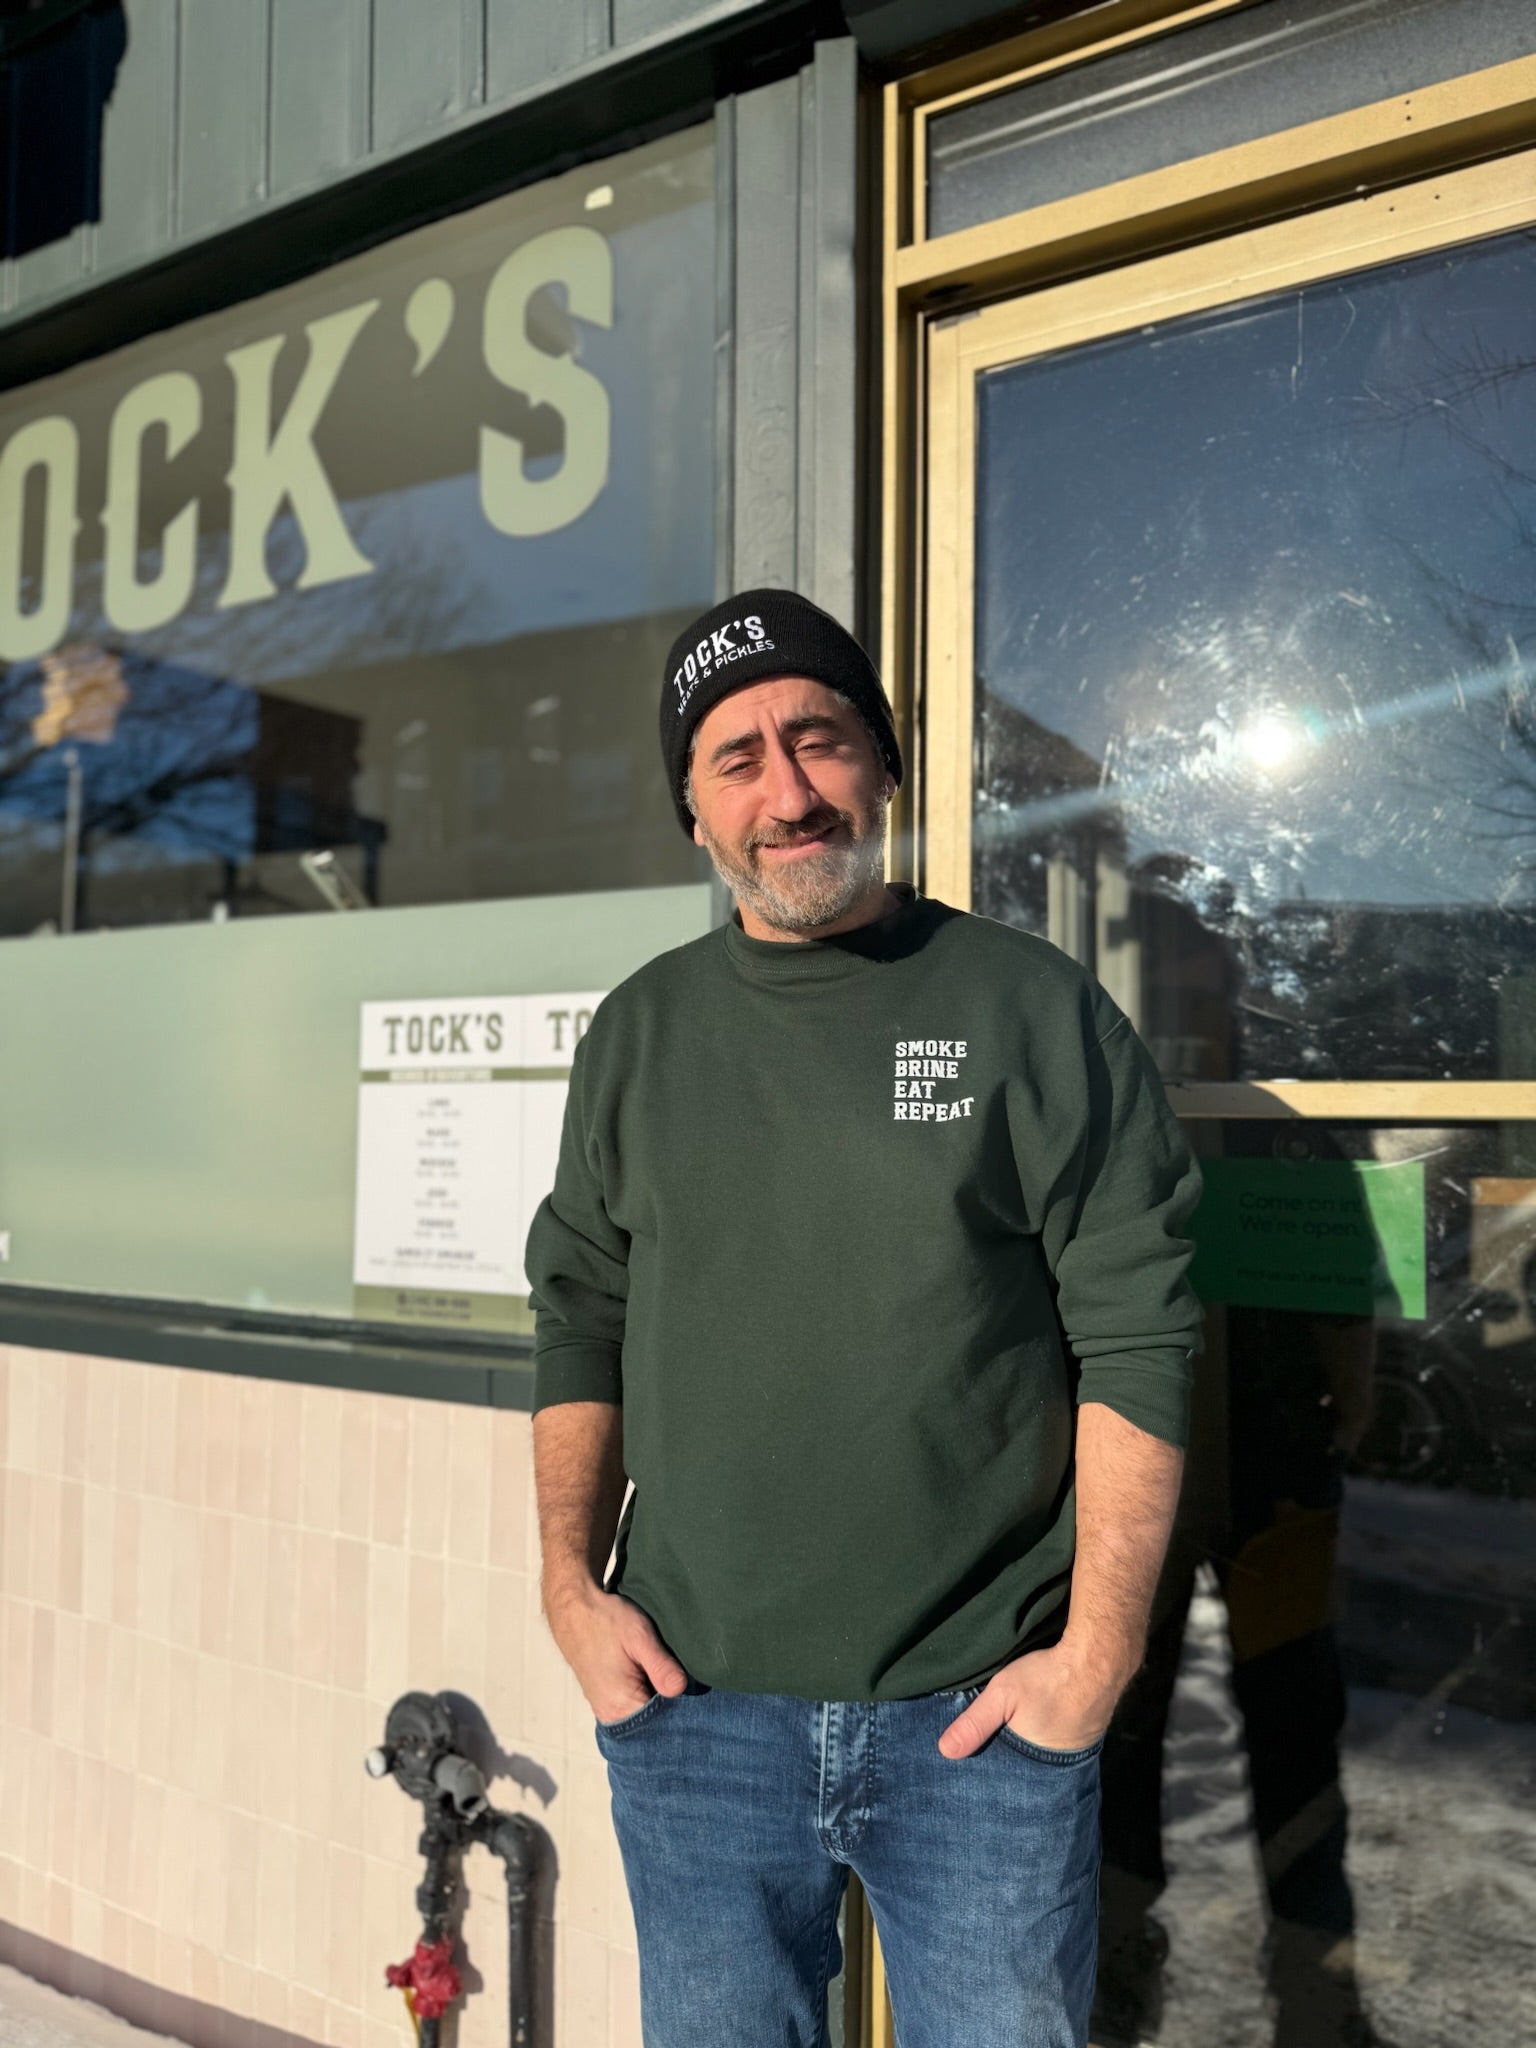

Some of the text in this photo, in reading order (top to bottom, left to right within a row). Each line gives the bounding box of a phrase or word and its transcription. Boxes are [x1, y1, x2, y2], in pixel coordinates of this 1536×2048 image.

[673, 615, 766, 699] TOCK'S
[677, 639, 775, 717] MEATS & PICKLES
[383, 1012, 504, 1055] TOCK'S
[895, 1039, 968, 1059] SMOKE
[894, 1059, 960, 1079] BRINE
[893, 1080, 937, 1100] EAT
[893, 1097, 975, 1123] REPEAT
[1238, 1191, 1303, 1211] Come
[1307, 1197, 1335, 1212] on
[1238, 1214, 1297, 1234] We're
